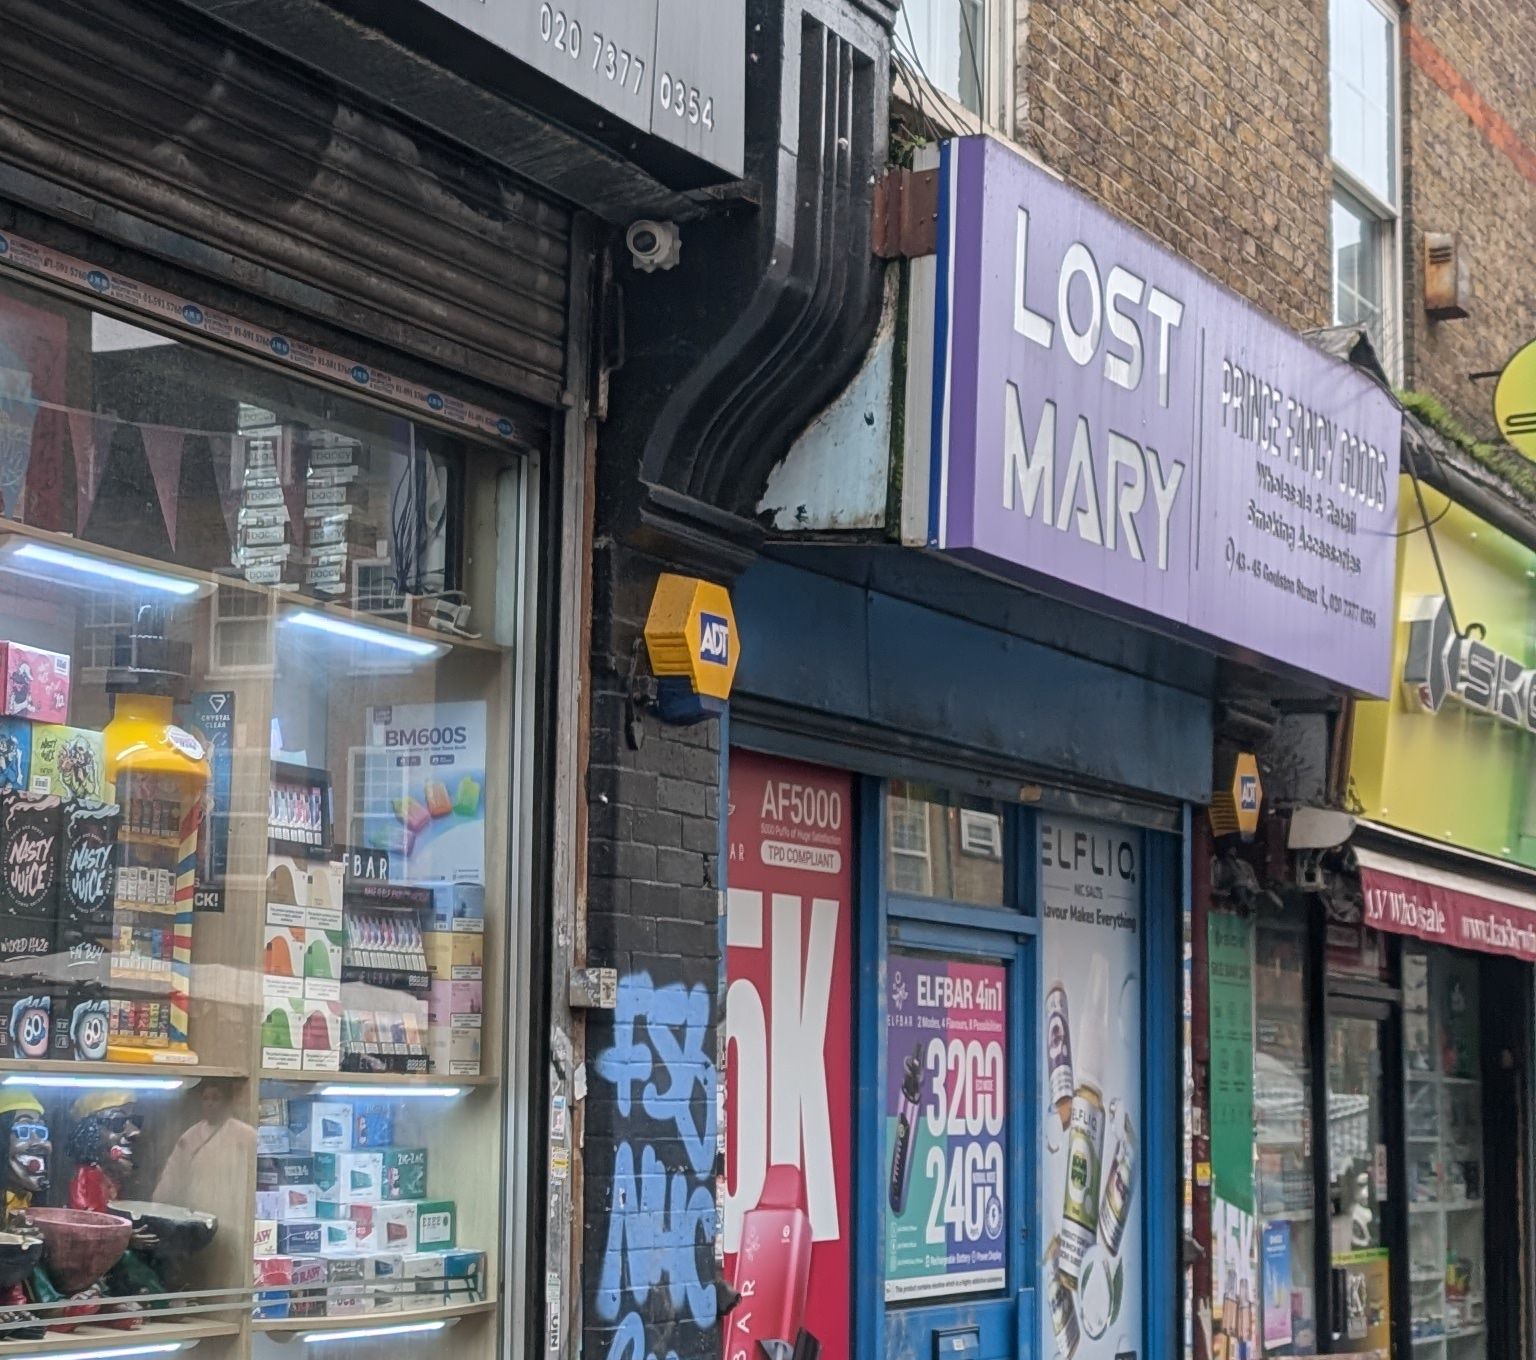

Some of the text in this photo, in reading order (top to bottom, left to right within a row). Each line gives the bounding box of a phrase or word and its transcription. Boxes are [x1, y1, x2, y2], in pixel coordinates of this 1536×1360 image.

[540, 2, 715, 132] 020 7377 0354
[1014, 205, 1186, 409] LOST
[1222, 358, 1389, 513] PRINCE FANCY GOODS
[1003, 379, 1186, 571] MARY
[1256, 461, 1313, 516] Wholesale
[1326, 498, 1357, 535] Retail
[1248, 499, 1362, 577] Smoking Accessories
[700, 621, 728, 658] ADT
[200, 713, 231, 722] CRYSTAL
[384, 726, 468, 748] BM600S
[760, 779, 841, 830] AF5000
[1241, 780, 1256, 805] ADT
[9, 833, 55, 865] NASTY
[70, 841, 112, 872] NASTY
[768, 844, 785, 862] TPD
[786, 846, 835, 869] COMPLIANT
[1069, 904, 1137, 934] Makes Everything
[69, 942, 85, 961] FAT
[917, 973, 1003, 1012] ELFBAR 4in1
[24, 1014, 42, 1042] 60
[84, 1018, 102, 1045] 60
[925, 1037, 1005, 1138] 3200
[299, 1267, 321, 1282] RAW
